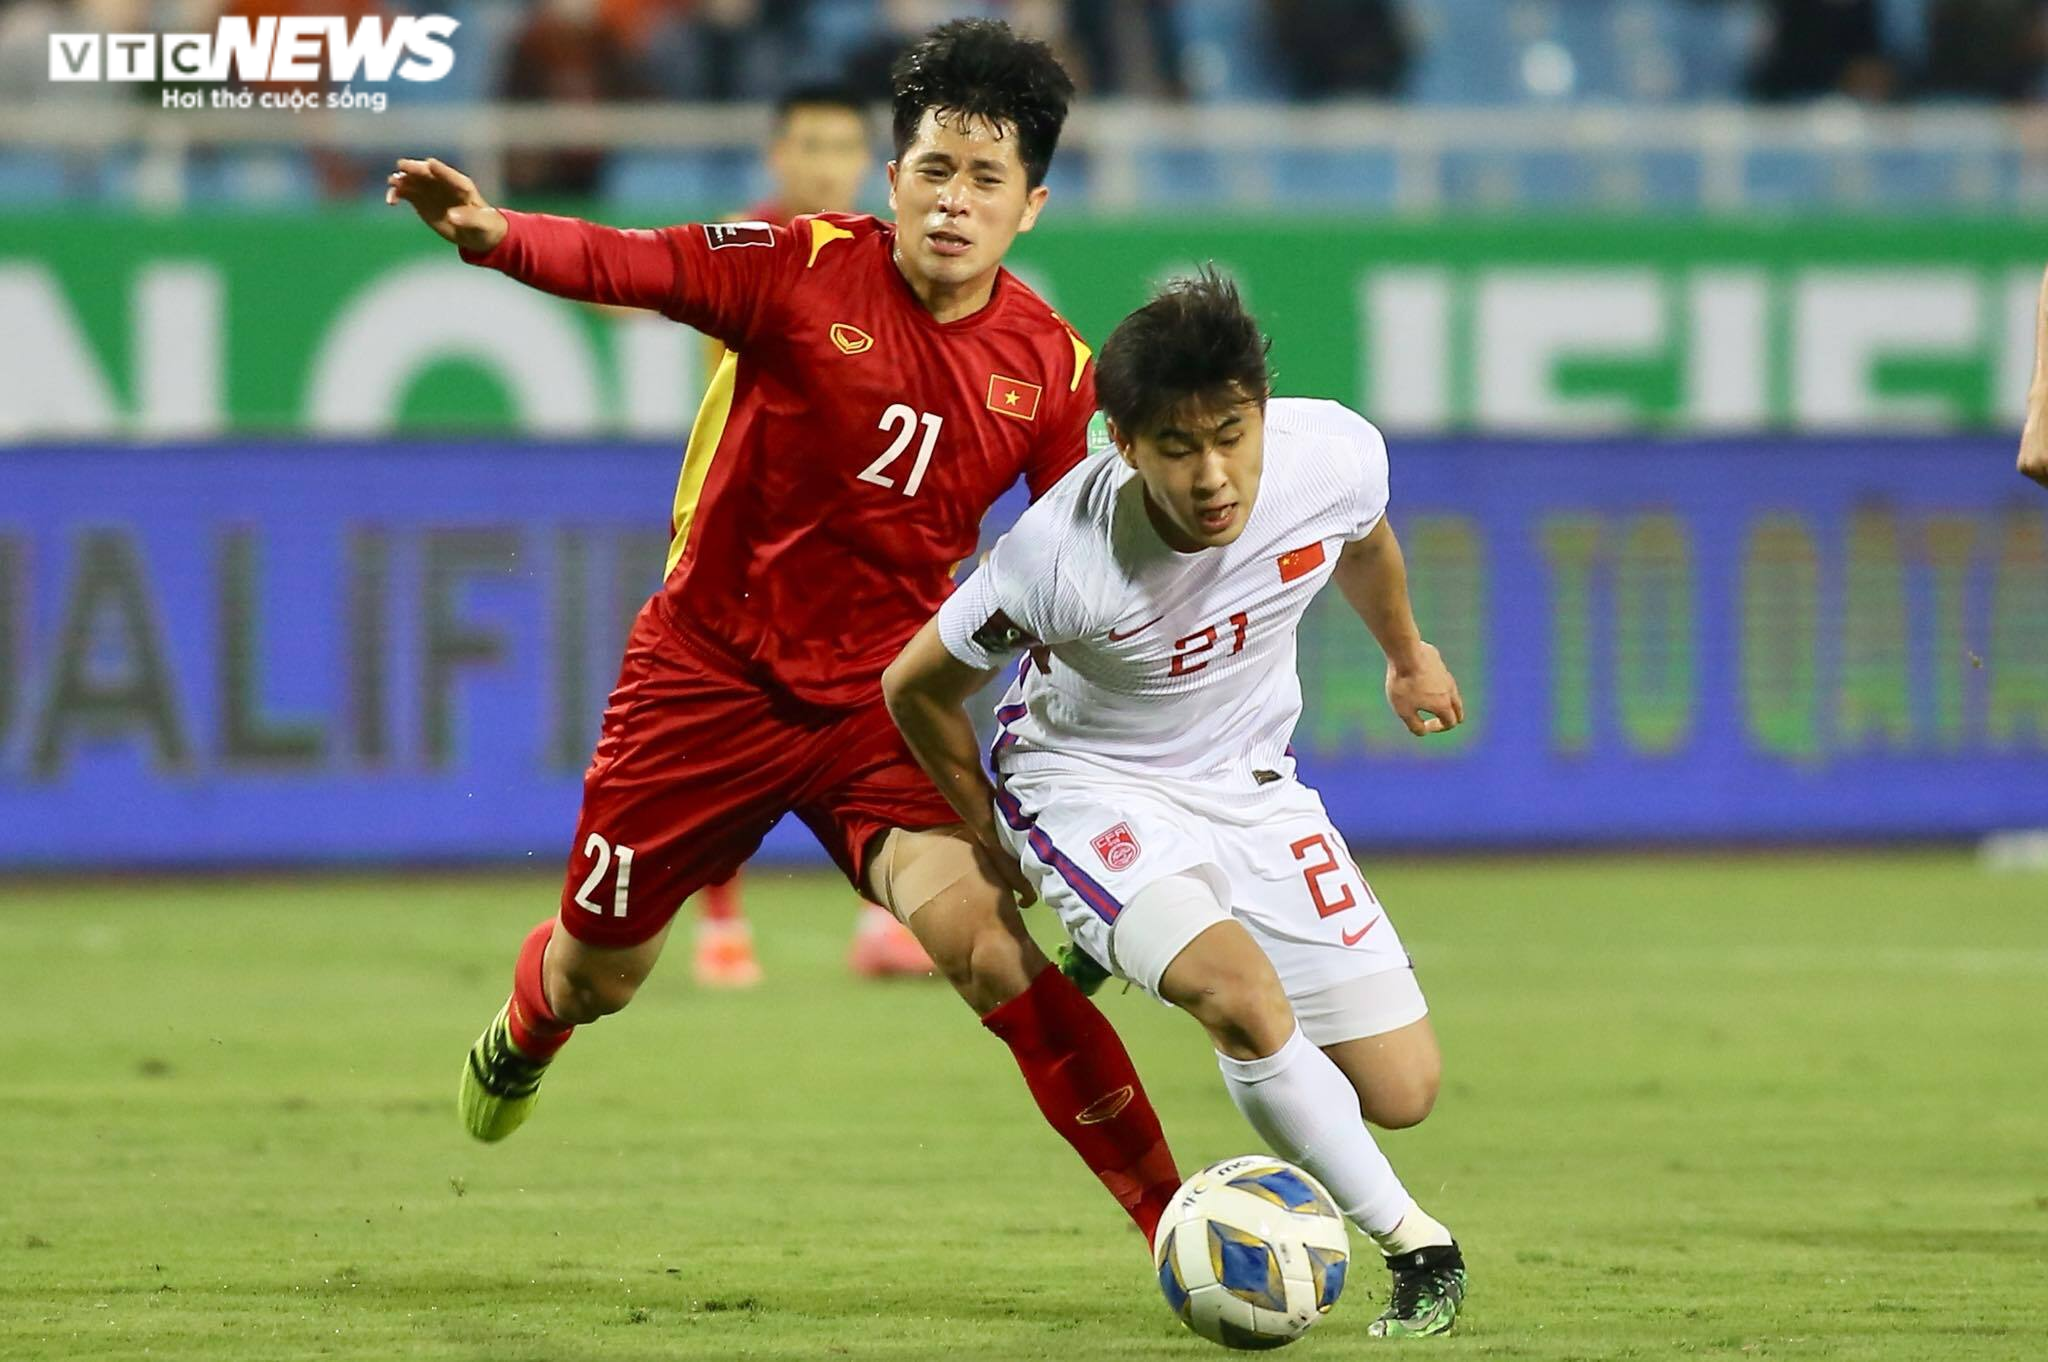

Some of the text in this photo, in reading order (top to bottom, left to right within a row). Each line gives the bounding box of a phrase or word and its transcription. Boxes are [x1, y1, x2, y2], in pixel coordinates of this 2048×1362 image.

[856, 403, 944, 497] 21
[1167, 611, 1249, 678] 21
[574, 832, 635, 918] 21
[1289, 833, 1376, 920] 2
